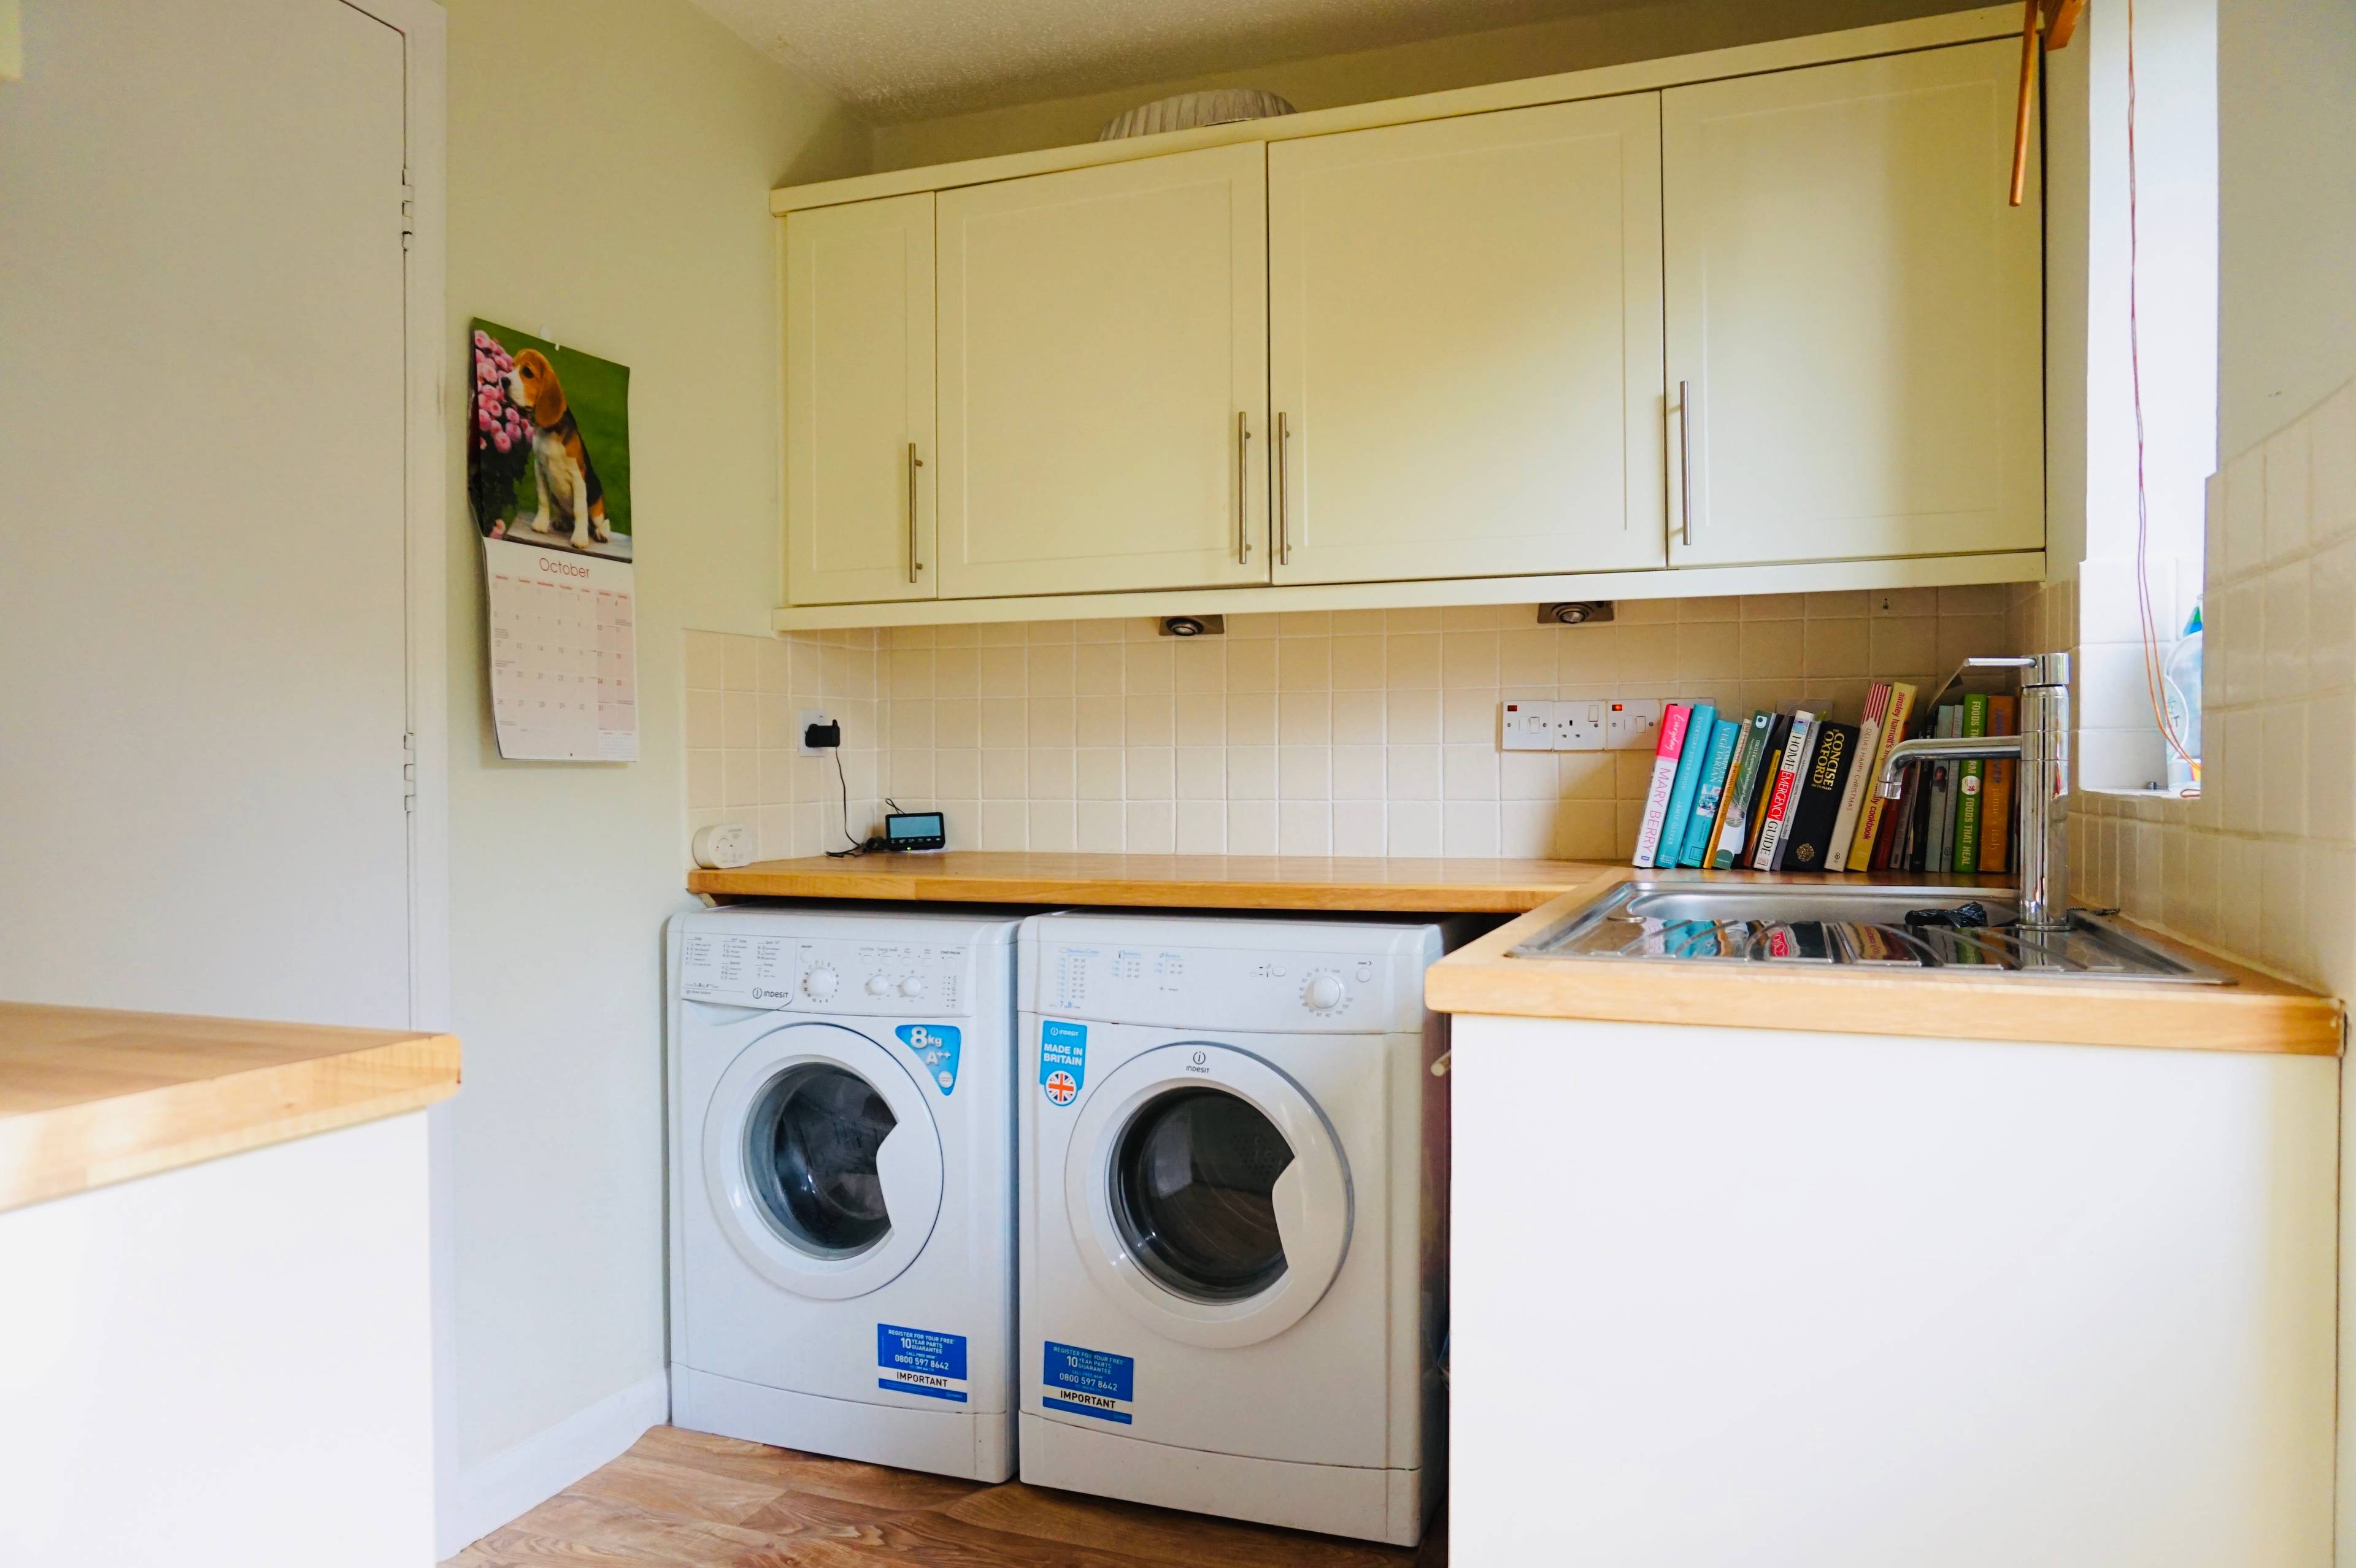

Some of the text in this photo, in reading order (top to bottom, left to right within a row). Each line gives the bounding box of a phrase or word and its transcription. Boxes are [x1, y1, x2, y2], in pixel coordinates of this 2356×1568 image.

[539, 558, 590, 578] October
[1885, 692, 1906, 748] ainsley harriott's
[1971, 701, 1981, 726] FOODS
[1666, 714, 1684, 751] Everyday
[1691, 717, 1702, 750] EVERYDAY
[1711, 727, 1729, 783] VEGETARIAN
[1717, 746, 1731, 784] COMPLETE
[1784, 736, 1801, 771] HOME
[1812, 730, 1834, 784] OXFORD
[1823, 732, 1845, 786] CONCISE
[1847, 728, 1871, 811] DELIA'S HAPPY CHRISTMAS
[1770, 771, 1792, 820] EMERGENCY
[1642, 768, 1671, 852] MARY BERRY
[1668, 822, 1677, 845] OLIVER
[1863, 807, 1876, 840] cookbook
[1961, 798, 1974, 864] FOODS THAT HEAL
[1761, 821, 1778, 855] GUIDE
[910, 1026, 942, 1048] 8kg
[926, 1050, 950, 1066] A++
[1043, 1053, 1082, 1066] BRITAIN
[1044, 1043, 1083, 1056] MADE IN
[888, 1329, 913, 1338] REGISTER
[901, 1337, 912, 1348] 10
[911, 1345, 942, 1354] GUARANTEE
[1053, 1347, 1080, 1356] REGISTER
[895, 1355, 913, 1364] 0800
[915, 1358, 928, 1366] 597
[930, 1360, 949, 1370] 8642
[1066, 1356, 1078, 1367] 10
[1078, 1363, 1112, 1374] GUARANTEE
[897, 1372, 947, 1387] IMPORTANT
[1060, 1373, 1079, 1383] 0800
[1081, 1377, 1096, 1386] 597
[1098, 1380, 1118, 1391] 8642
[1060, 1390, 1116, 1409] IMPORTANT
